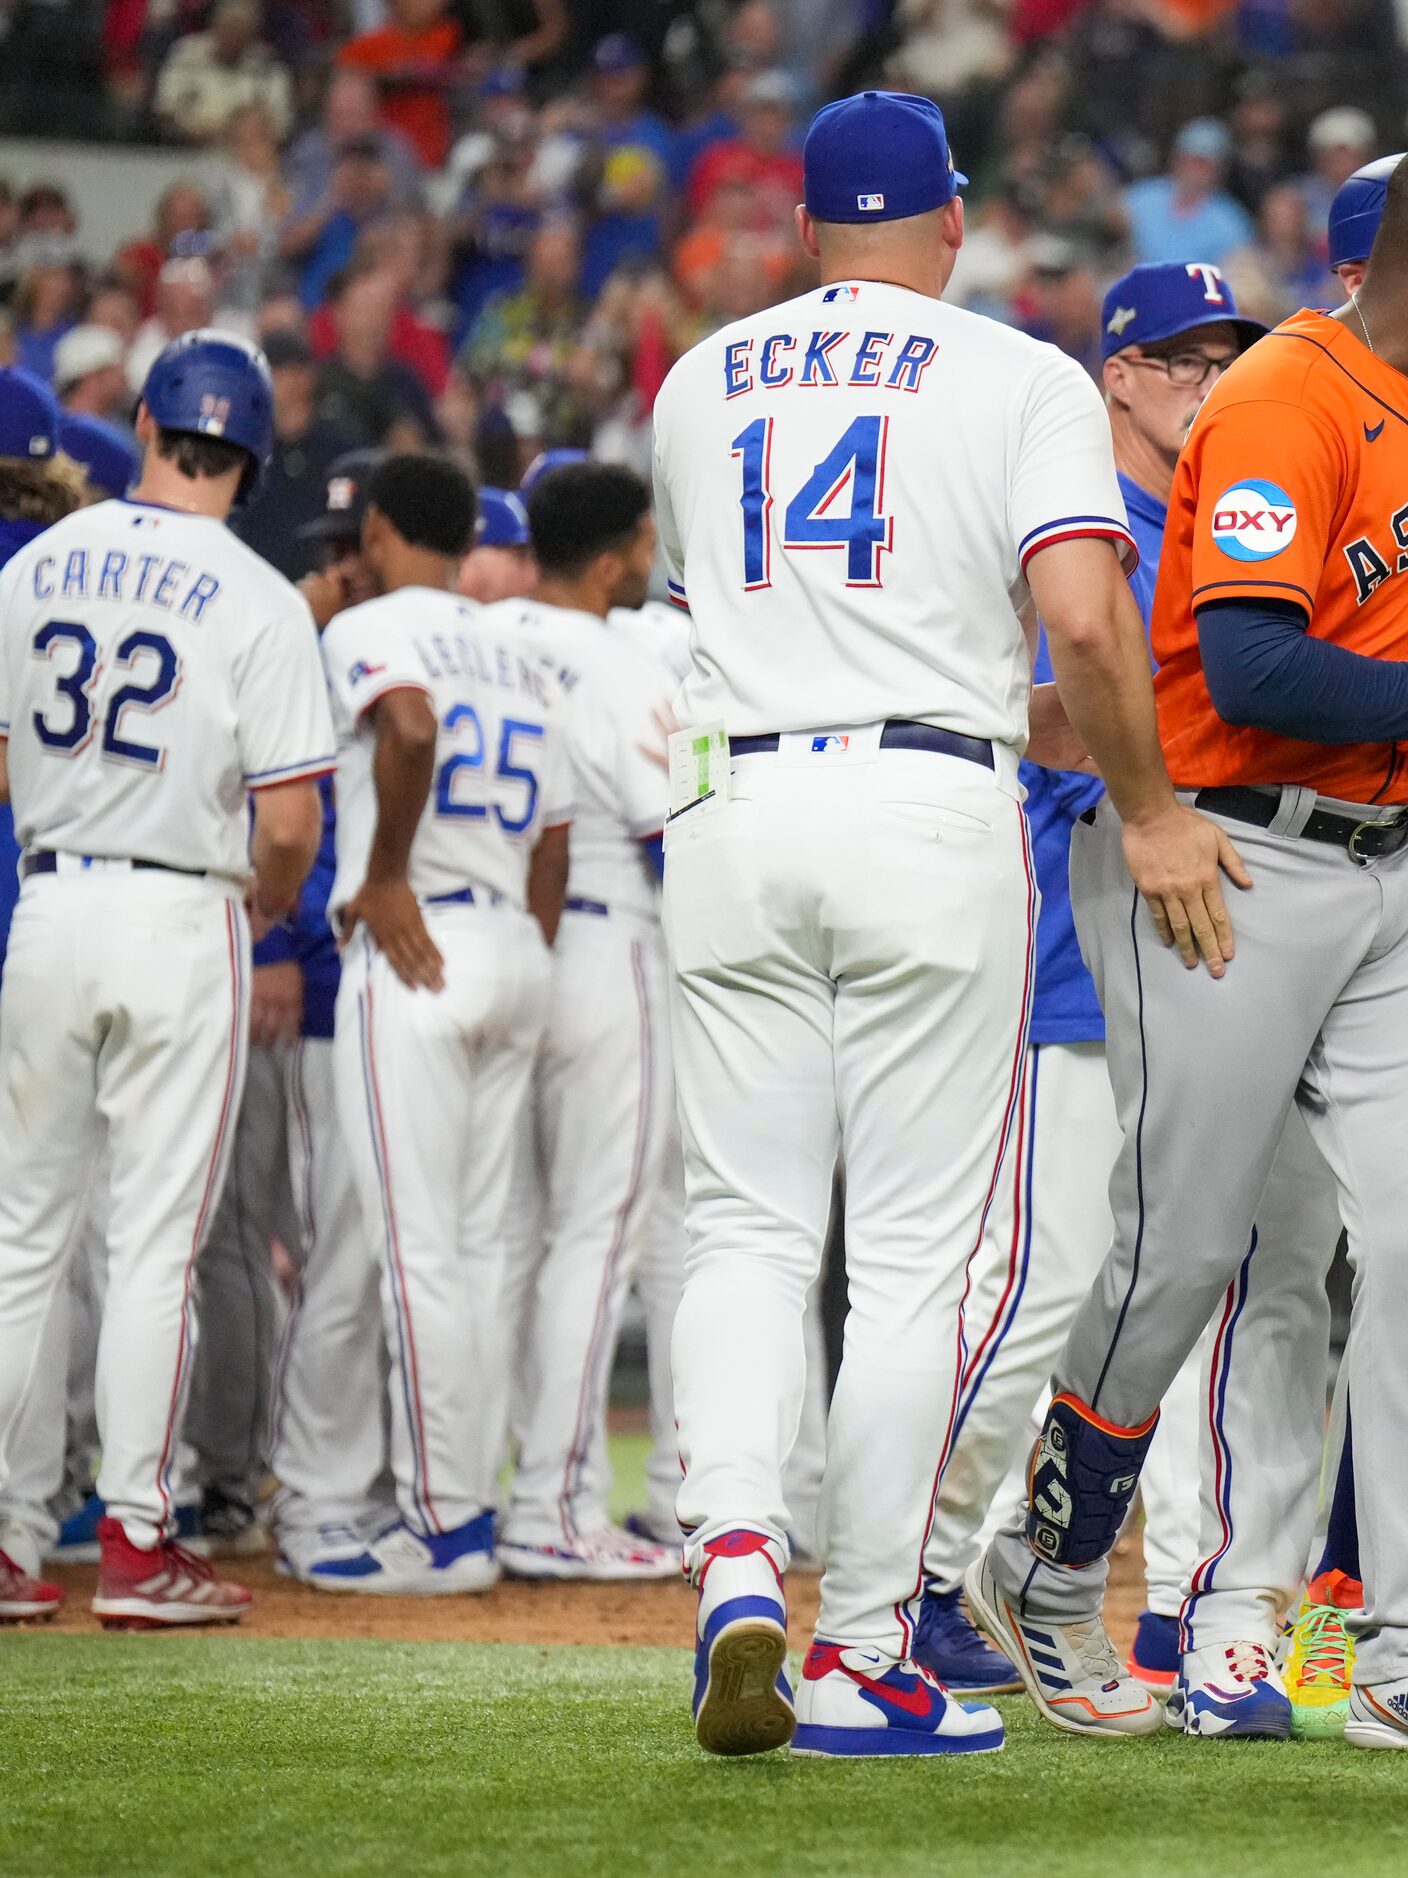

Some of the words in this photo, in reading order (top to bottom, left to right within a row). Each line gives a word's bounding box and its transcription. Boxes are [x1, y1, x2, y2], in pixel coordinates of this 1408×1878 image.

[1185, 262, 1224, 305] T
[724, 331, 938, 400] ECKER
[729, 414, 894, 591] 14
[1214, 510, 1294, 532] OXY
[33, 549, 223, 625] CARTER
[33, 619, 183, 774] 32
[435, 702, 547, 837] 25
